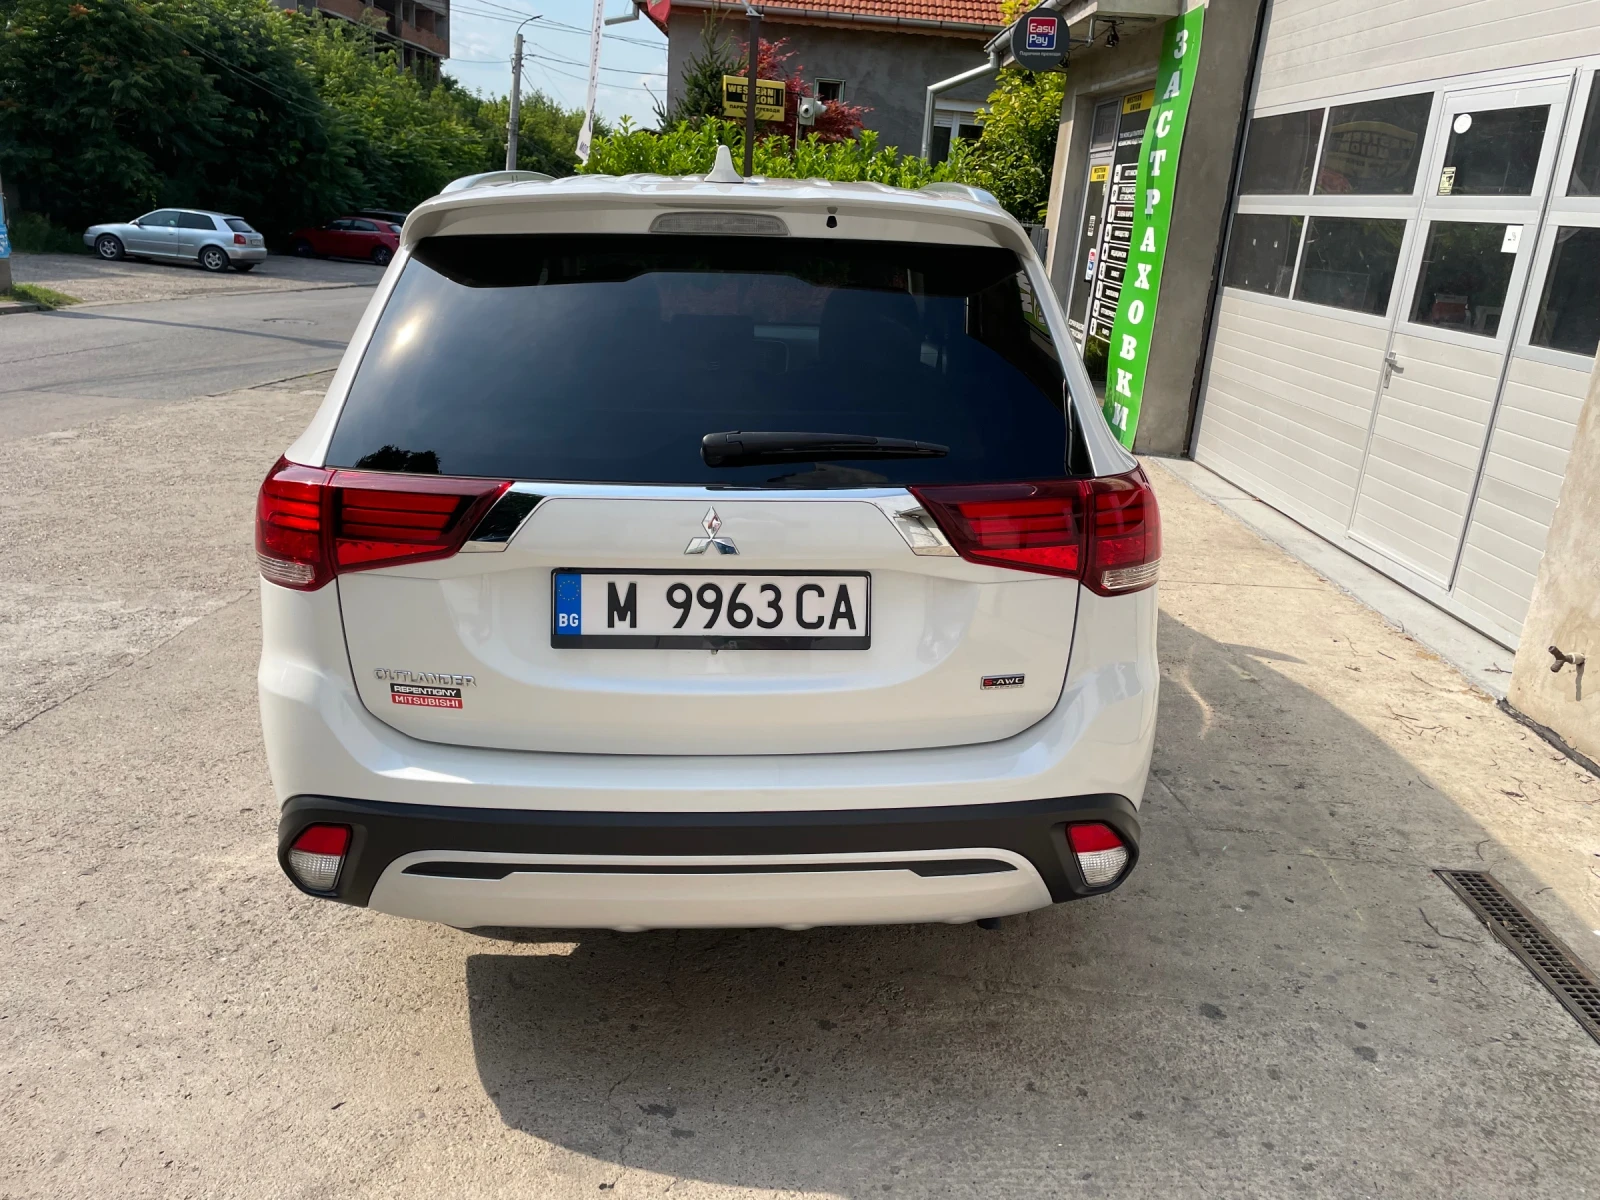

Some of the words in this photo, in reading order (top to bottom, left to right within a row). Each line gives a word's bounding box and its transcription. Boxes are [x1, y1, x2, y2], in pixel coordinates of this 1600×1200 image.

[1030, 23, 1054, 35] Easy
[1029, 34, 1048, 47] Pay
[727, 84, 774, 97] WESERN
[742, 94, 774, 105] UION
[1111, 29, 1189, 432] ЗАСТРАХОВКИ
[607, 582, 637, 629] M
[666, 583, 784, 630] 9963
[796, 584, 857, 630] CA
[558, 613, 579, 627] BG
[374, 668, 477, 687] OUTLANDER
[984, 677, 1024, 686] S-AWC
[394, 685, 457, 697] REPENTIGNY
[395, 695, 459, 708] MITSUBISHI
